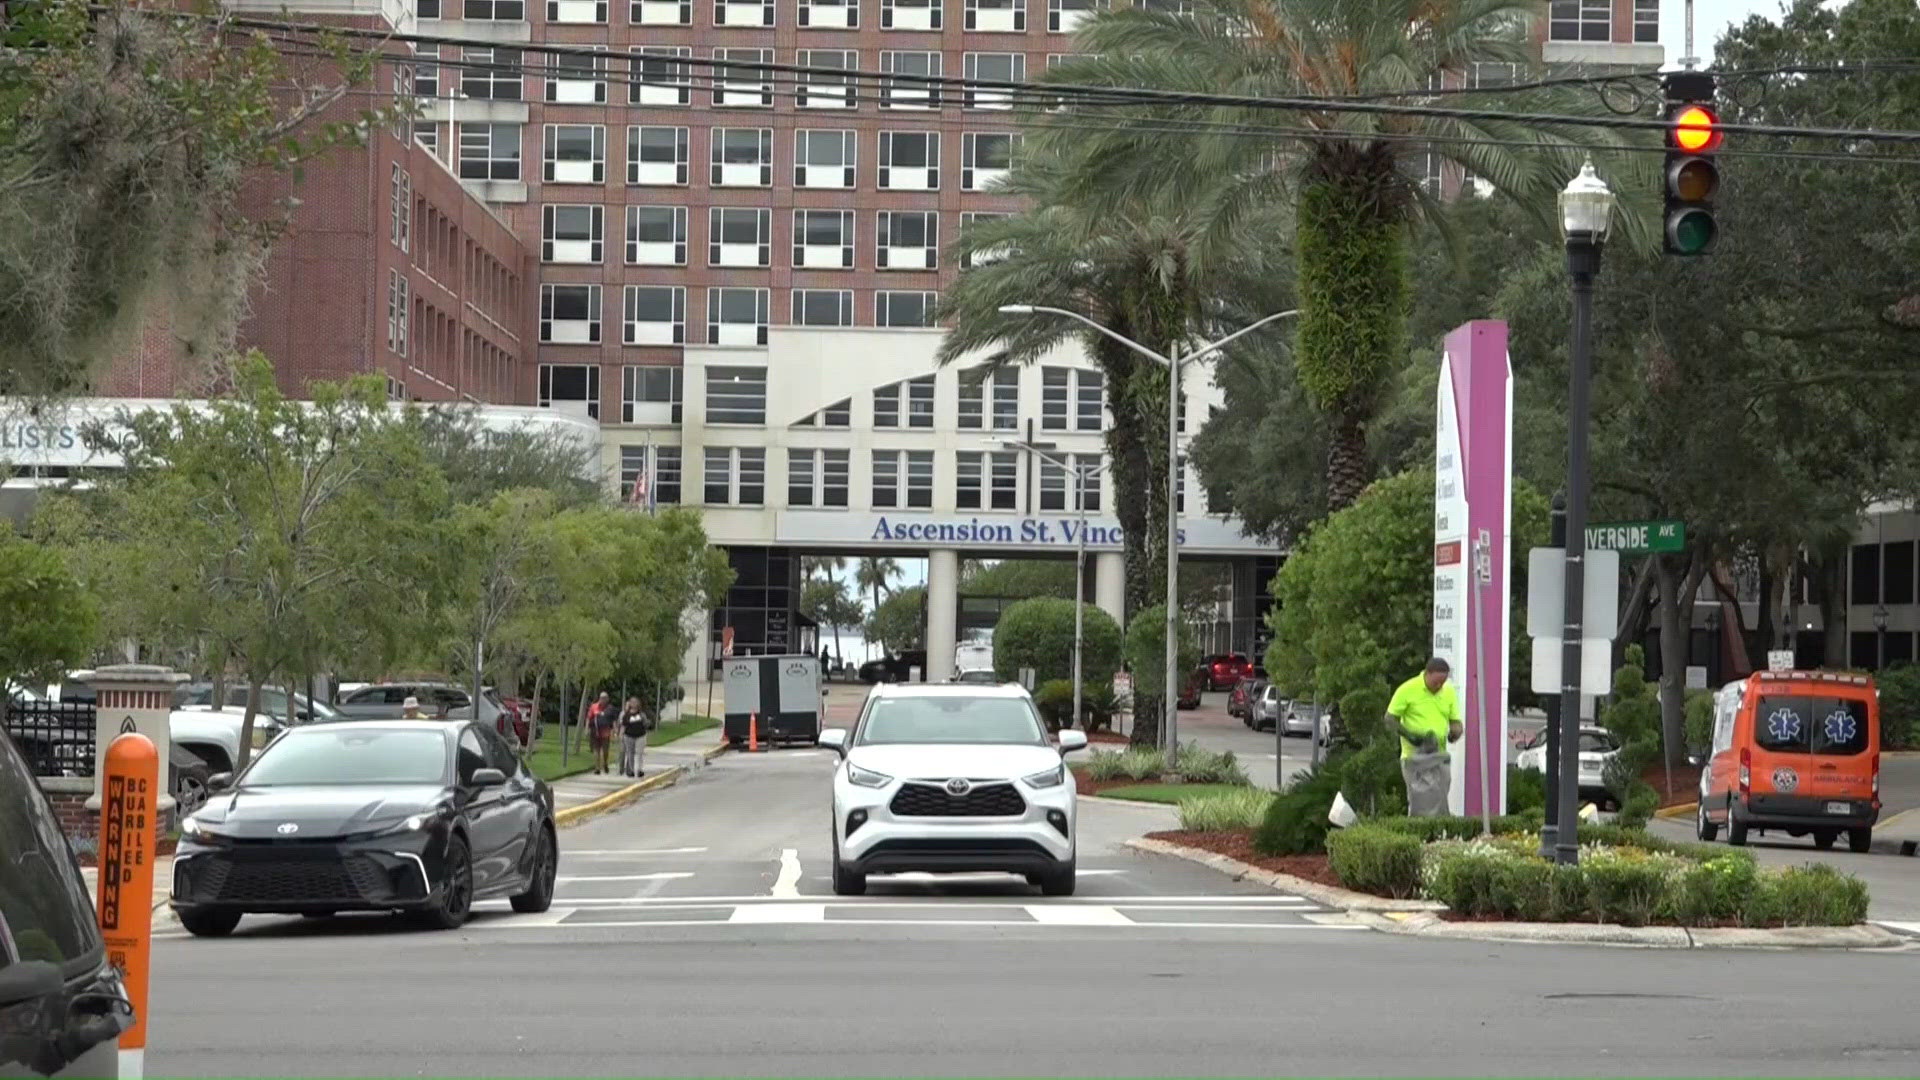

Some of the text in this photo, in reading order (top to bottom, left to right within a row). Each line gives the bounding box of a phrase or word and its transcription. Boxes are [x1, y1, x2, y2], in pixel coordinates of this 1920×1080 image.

[872, 516, 1012, 542] Ascension
[1021, 518, 1055, 544] St.
[1584, 524, 1675, 550] IVERSIDE AVE
[104, 780, 123, 923] WARNING
[123, 777, 137, 883] BURIED
[135, 777, 147, 866] CABLE
